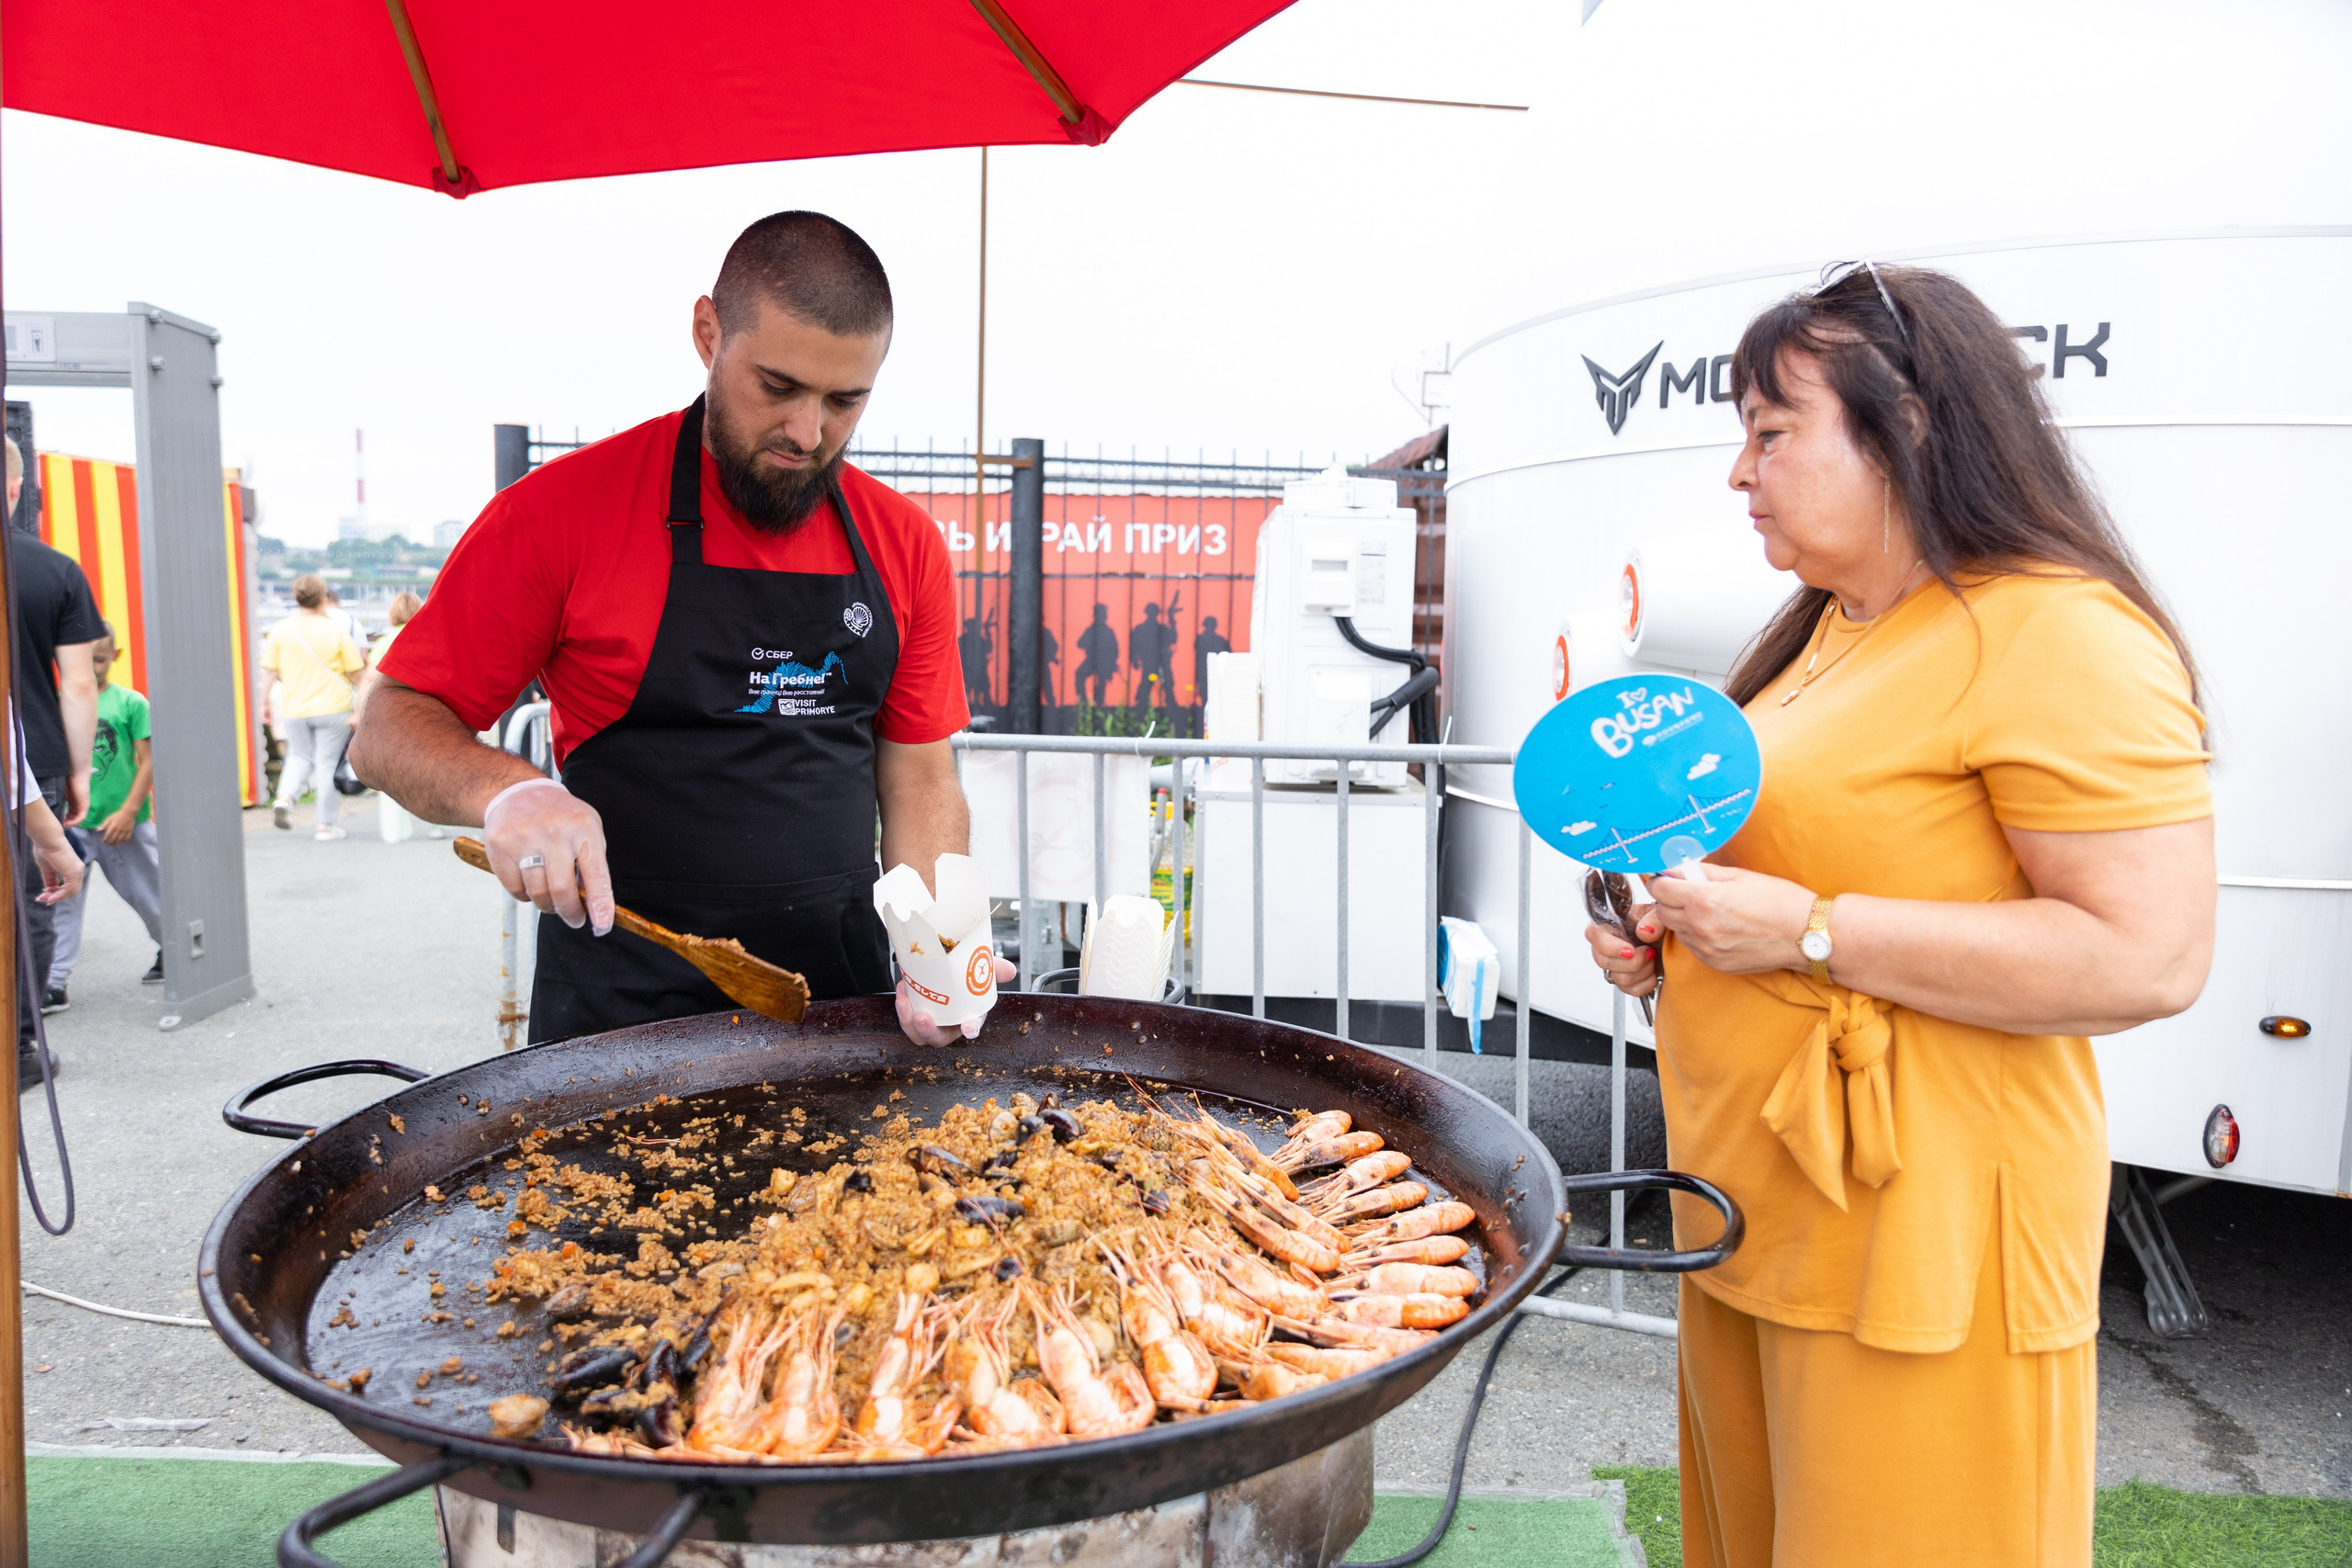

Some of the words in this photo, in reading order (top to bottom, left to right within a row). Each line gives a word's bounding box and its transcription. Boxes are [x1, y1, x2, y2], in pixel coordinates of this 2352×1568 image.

[1125, 522, 1227, 556] ПРИЗ
[765, 650, 793, 660] СБЕР
[795, 699, 817, 707] VISIT
[1615, 690, 1636, 709] I
[796, 705, 835, 716] PRIMORYE
[1590, 685, 1694, 759] BUSAN
